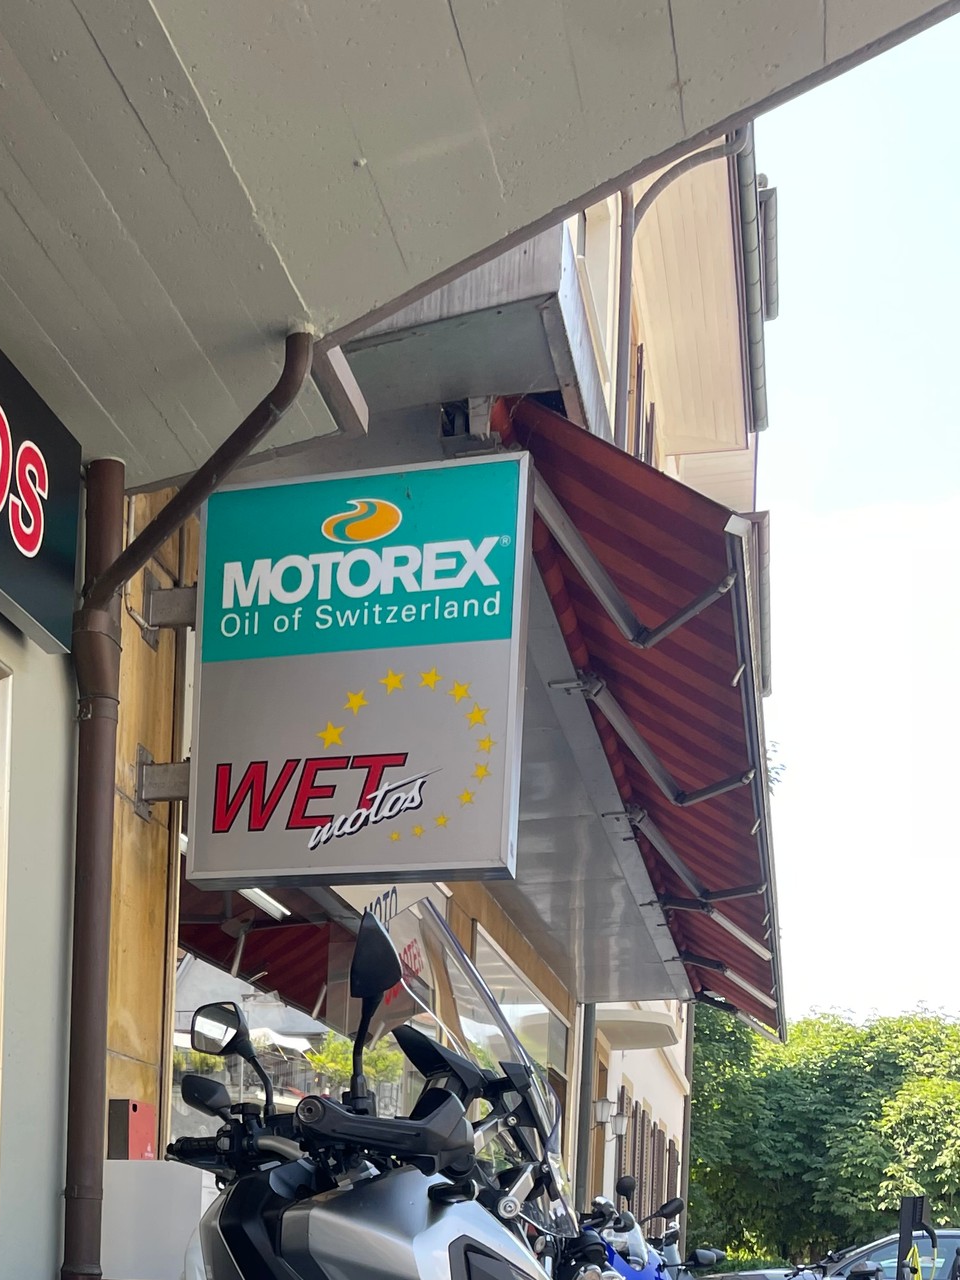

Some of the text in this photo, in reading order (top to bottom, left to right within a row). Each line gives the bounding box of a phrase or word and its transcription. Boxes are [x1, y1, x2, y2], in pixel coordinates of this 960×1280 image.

[221, 536, 500, 609] MOTOREX
[220, 591, 500, 638] Oil of Switzerland
[212, 752, 409, 834] WET
[308, 767, 444, 851] motos
[364, 886, 398, 934] OTO
